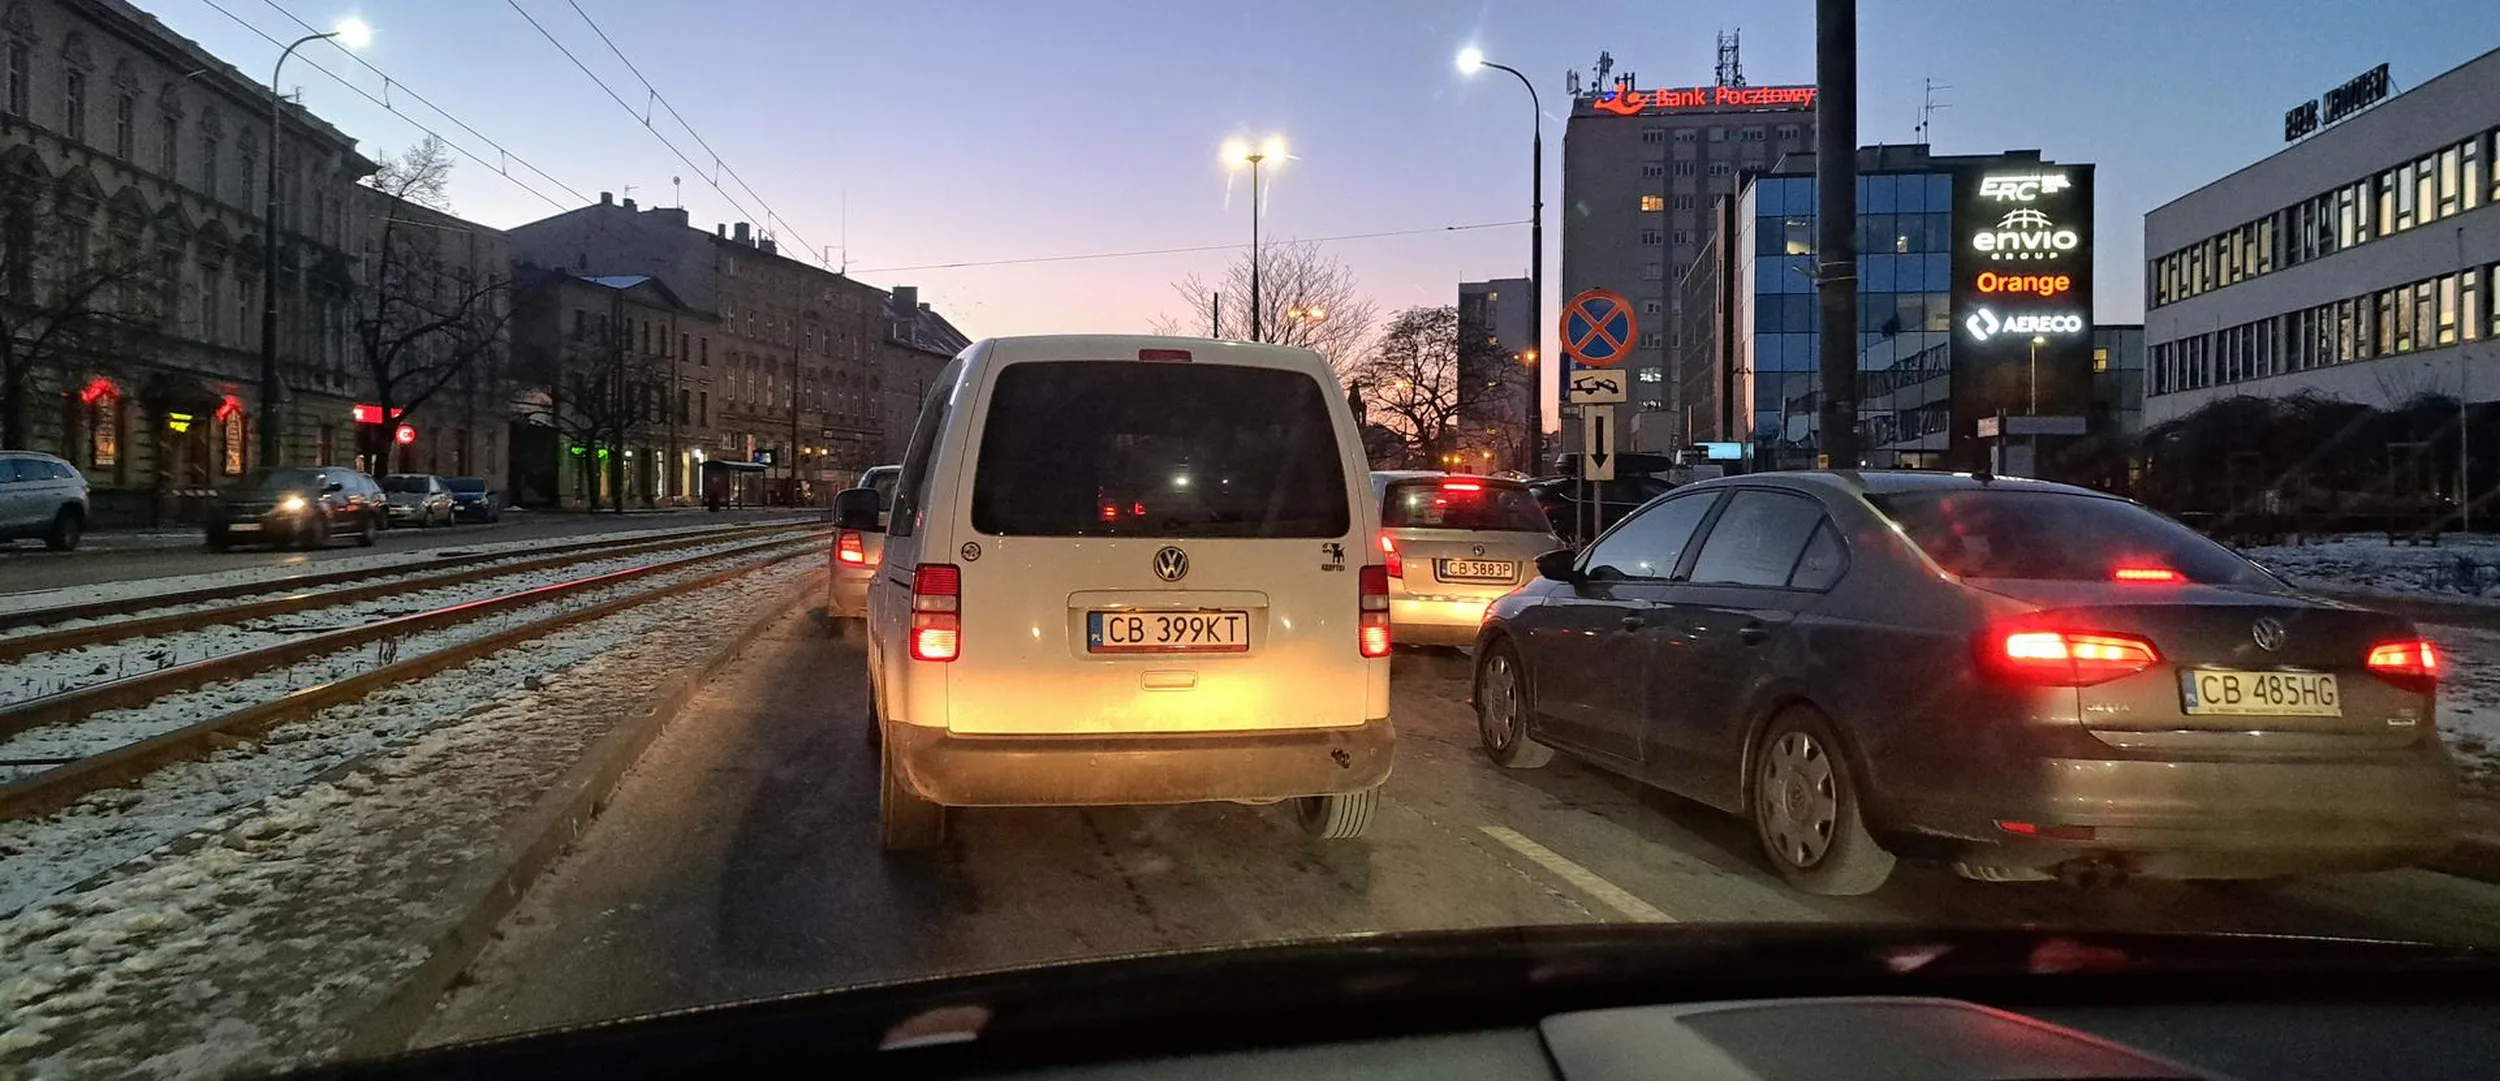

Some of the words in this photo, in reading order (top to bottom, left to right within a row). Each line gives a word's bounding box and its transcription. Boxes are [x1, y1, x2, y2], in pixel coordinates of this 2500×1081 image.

[1656, 87, 1705, 107] Bank
[1716, 86, 1815, 107] Pocztowy
[1979, 175, 2041, 202] ERC
[1972, 229, 2078, 251] envio
[1990, 252, 2059, 261] GROUP
[1976, 271, 2071, 297] Orange
[2002, 315, 2083, 334] AERECO
[1448, 561, 1468, 575] CB
[1472, 562, 1511, 576] 5883P
[1091, 633, 1102, 643] PL
[1109, 616, 1145, 643] CB
[1156, 616, 1240, 643] 399KT
[2201, 674, 2242, 705] CB
[2252, 674, 2335, 707] 485HG
